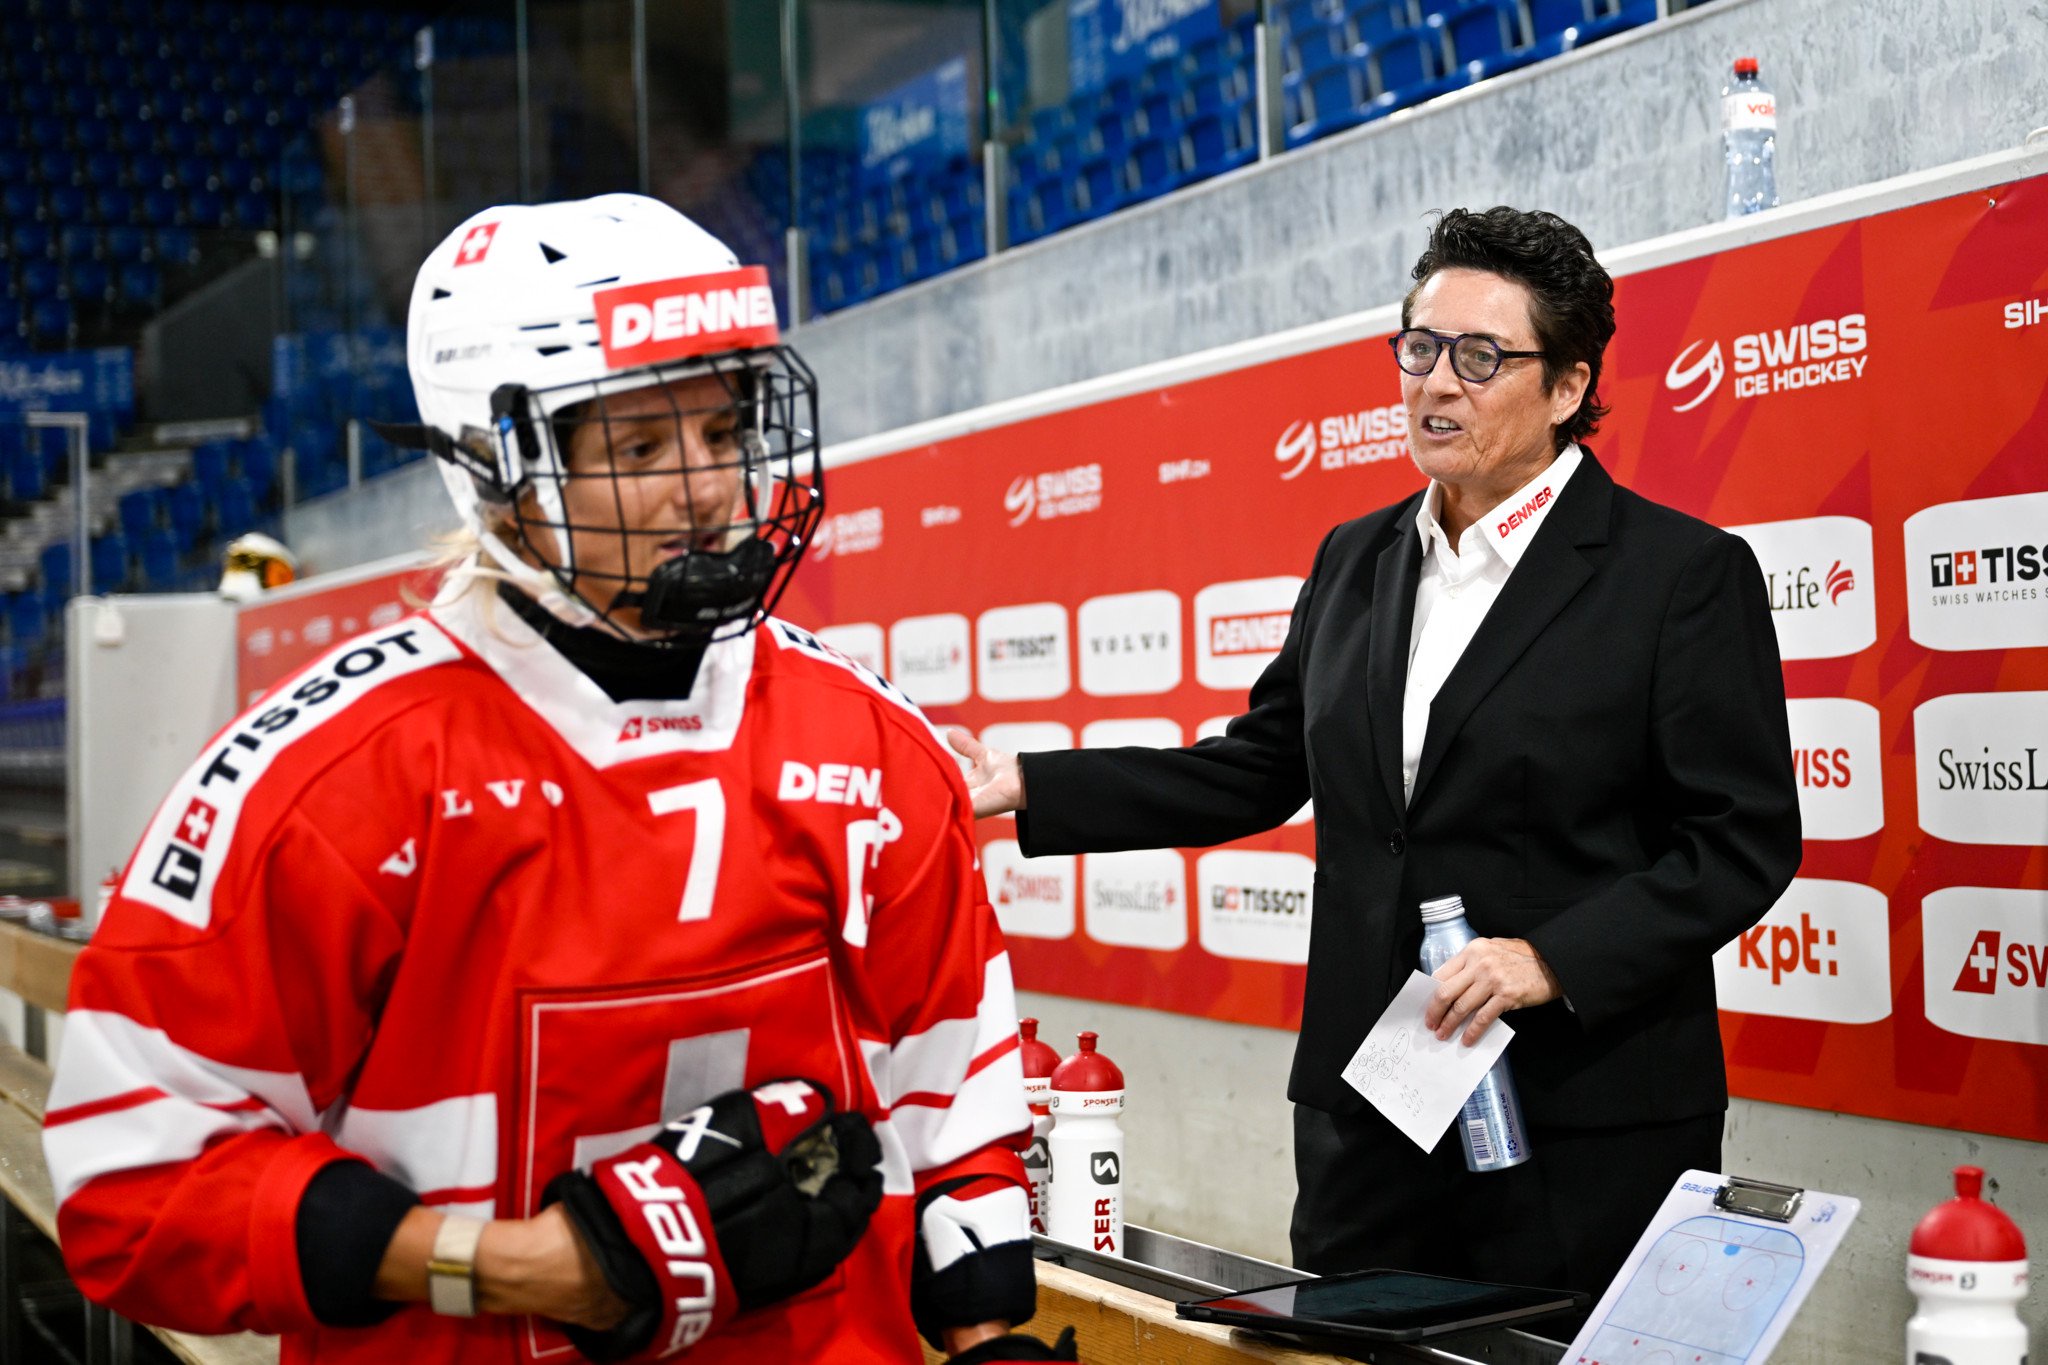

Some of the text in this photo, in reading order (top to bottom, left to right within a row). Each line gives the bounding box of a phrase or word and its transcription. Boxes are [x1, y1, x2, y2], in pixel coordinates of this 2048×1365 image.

[610, 284, 776, 350] DENNE
[1734, 313, 1867, 373] SWISS
[1735, 355, 1868, 399] ICE HOCKEY
[1320, 402, 1409, 450] SWISS
[1497, 485, 1553, 539] DENNER
[1981, 544, 2048, 583] TIS
[1932, 593, 1969, 607] SWISS
[1976, 588, 2037, 603] WATCHES
[1092, 632, 1168, 654] VOLVO
[200, 629, 421, 787] TISSOT
[647, 715, 702, 733] SWISS
[1793, 747, 1851, 788] ISS
[647, 777, 726, 923] 7
[1243, 887, 1307, 915] TISSOT
[1083, 1097, 1118, 1107] SPONSER
